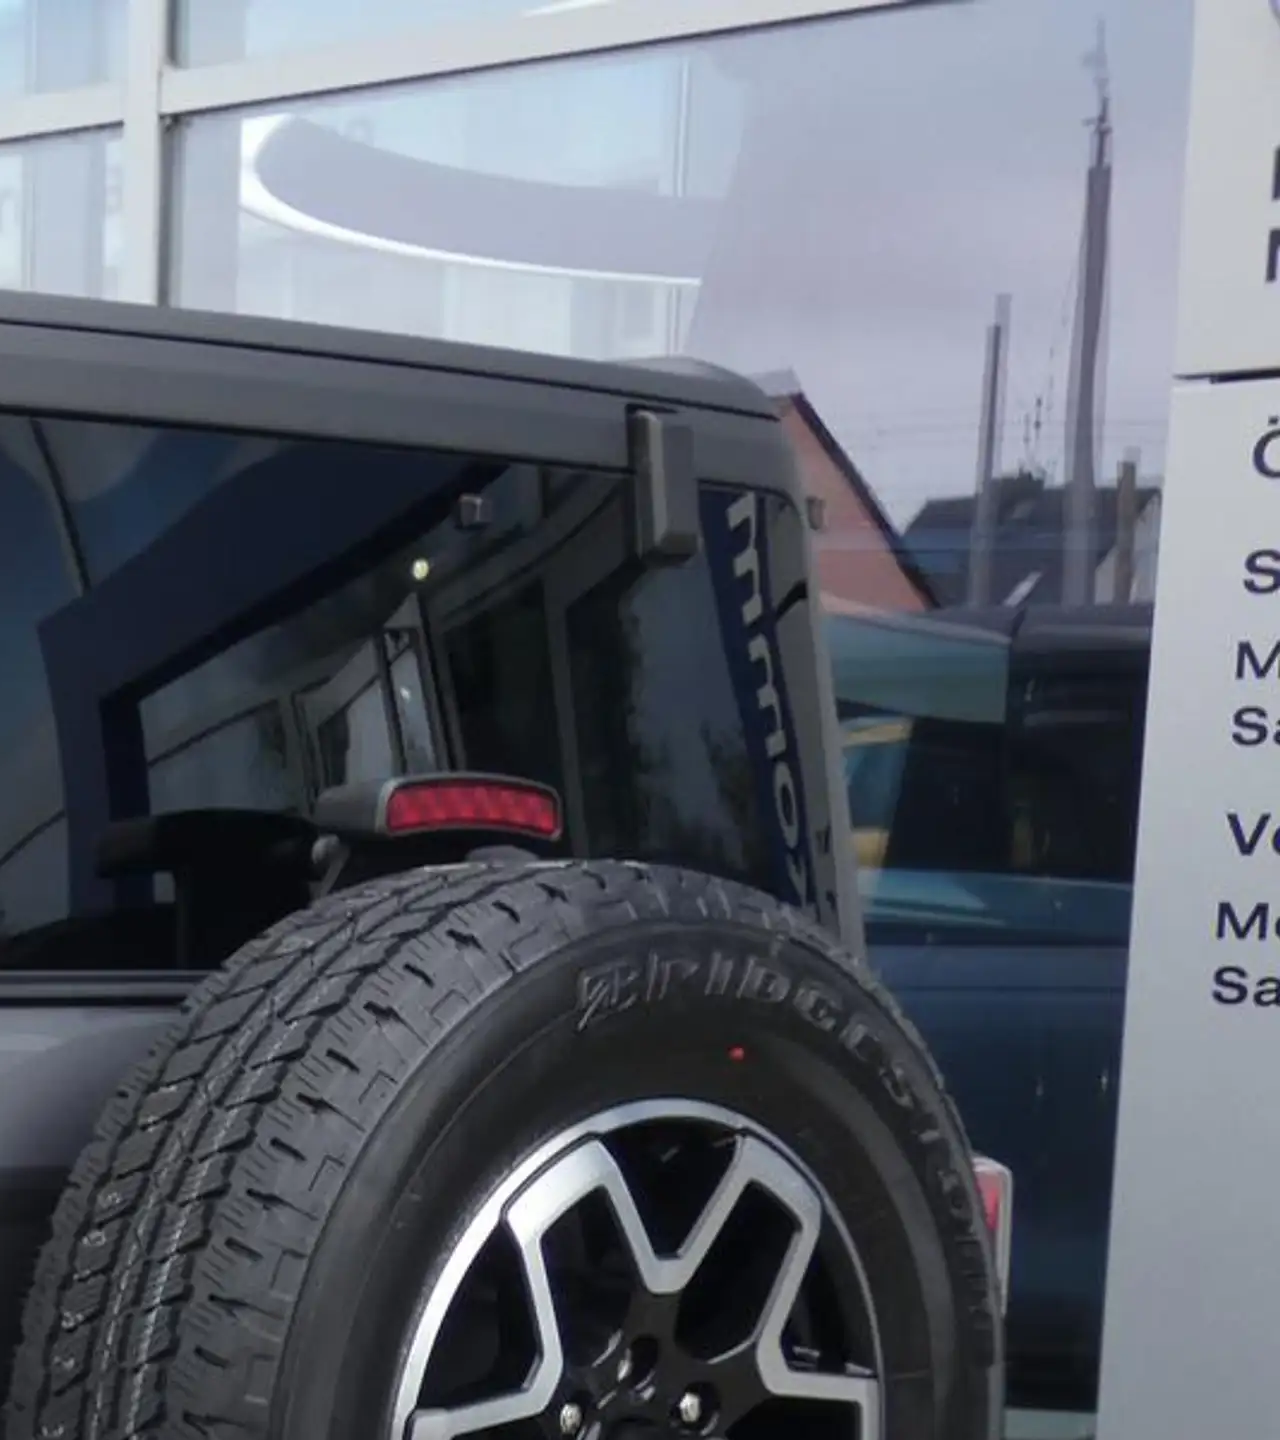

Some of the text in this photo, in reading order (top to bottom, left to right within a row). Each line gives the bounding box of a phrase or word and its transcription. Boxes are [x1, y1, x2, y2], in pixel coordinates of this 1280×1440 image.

[1232, 706, 1280, 746] S
[1227, 813, 1280, 856] V
[1216, 903, 1280, 940] M
